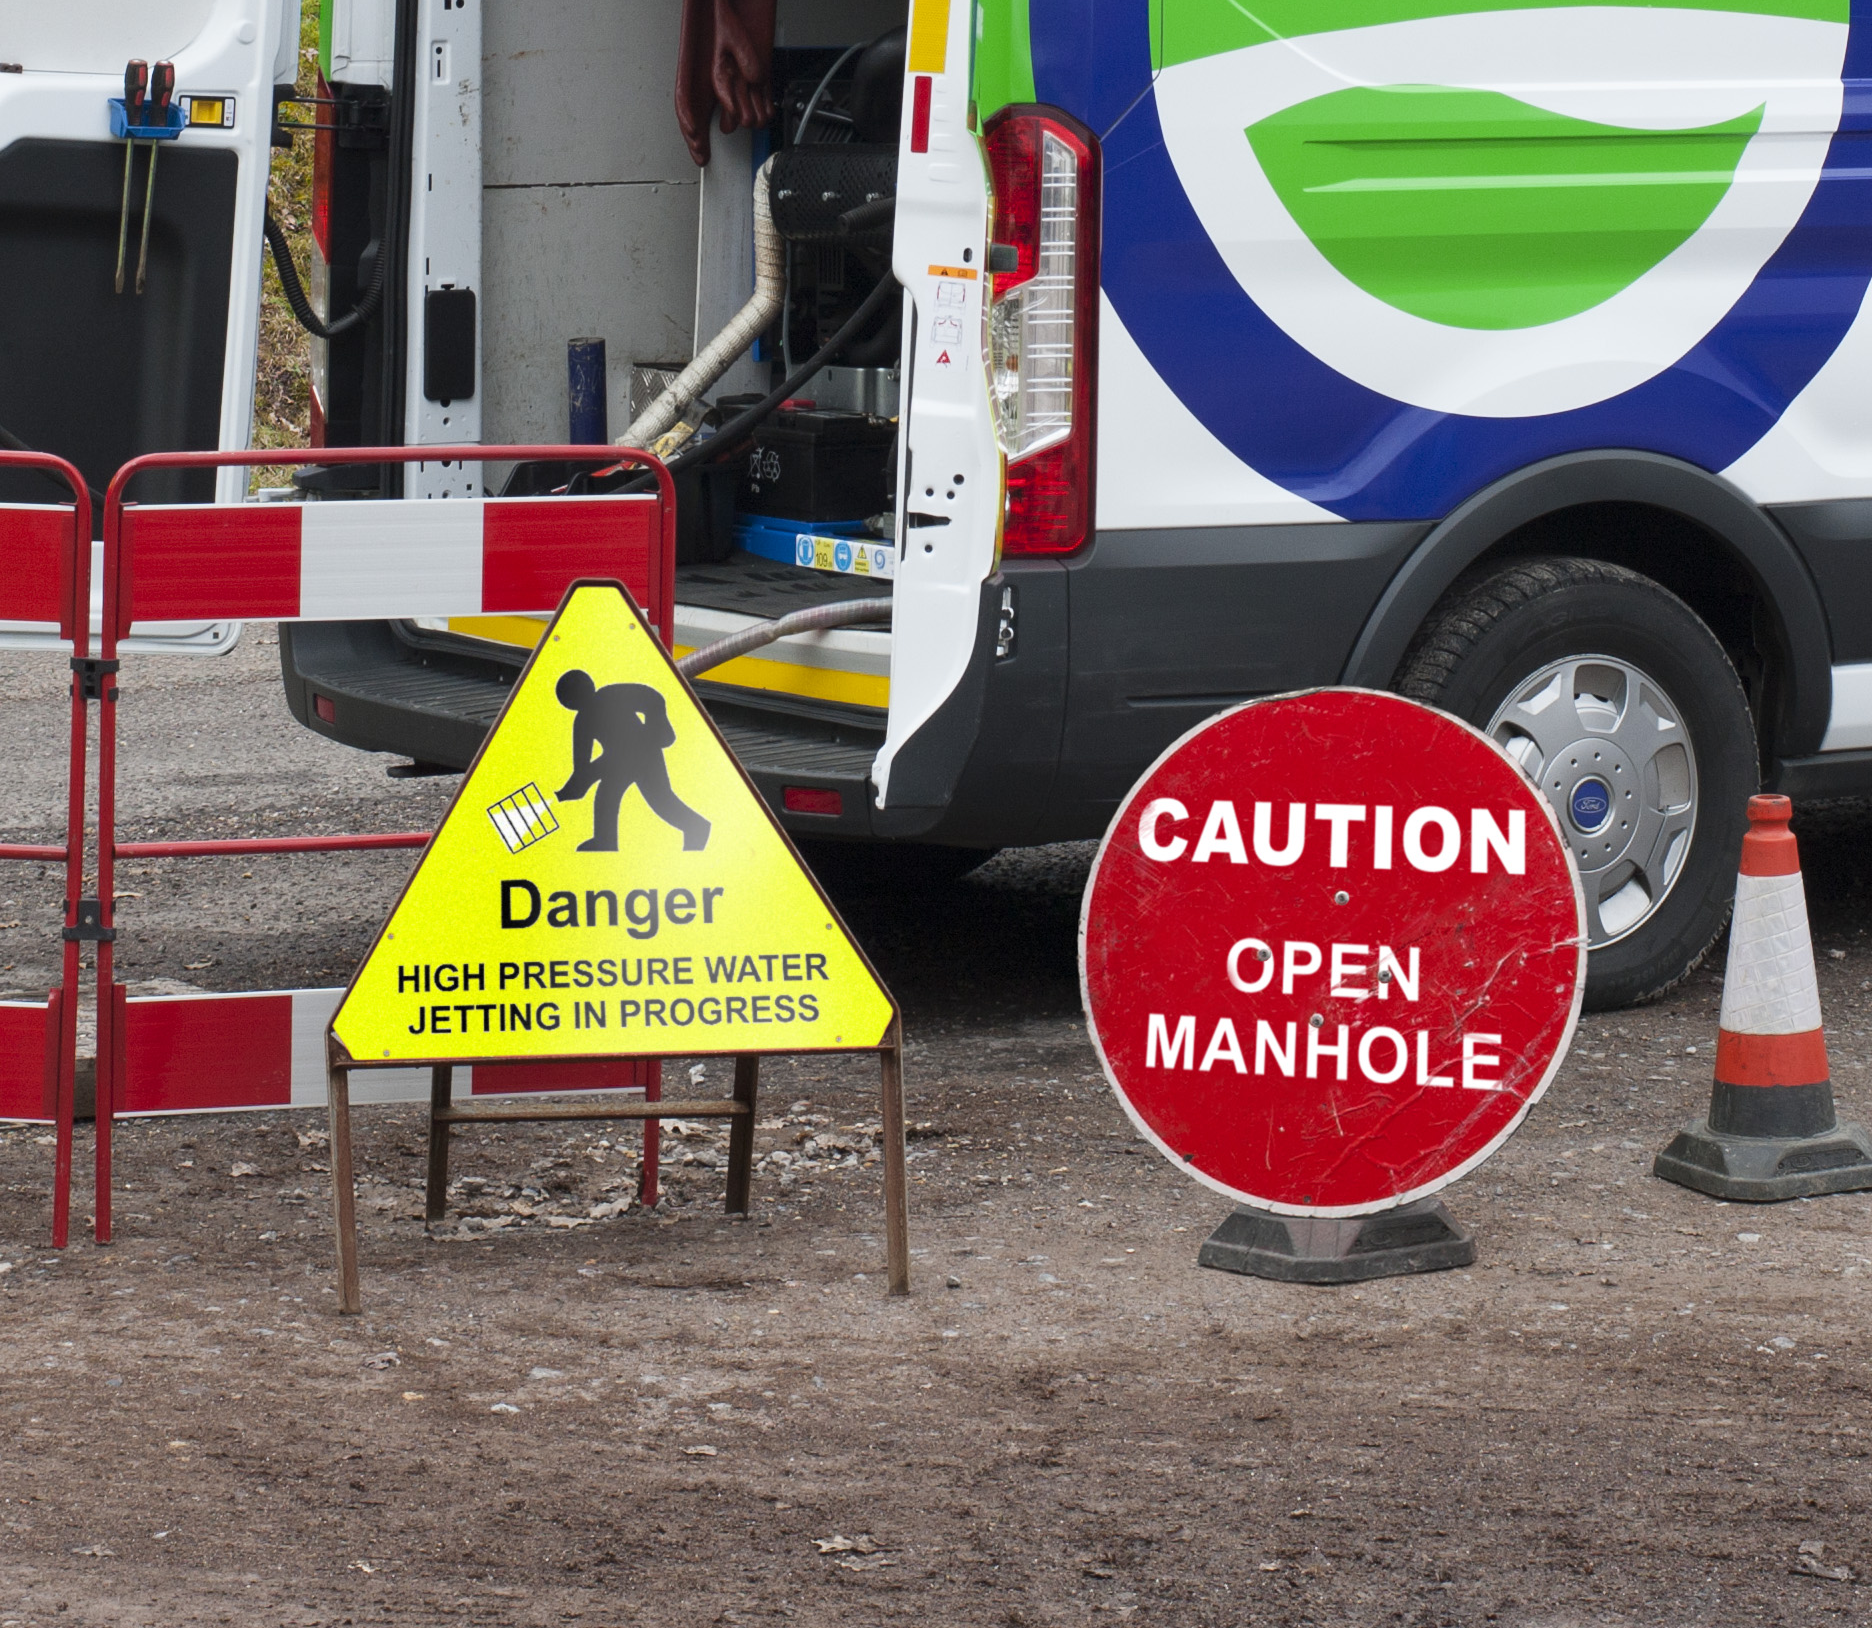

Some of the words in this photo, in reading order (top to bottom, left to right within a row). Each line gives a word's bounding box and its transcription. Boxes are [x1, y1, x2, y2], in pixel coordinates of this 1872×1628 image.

[1137, 797, 1527, 875] CAUTION
[500, 879, 724, 939] Danger
[398, 964, 485, 993] HIGH
[499, 957, 694, 991] PRESSURE
[704, 953, 829, 983] WATER
[1227, 938, 1420, 1002] OPEN
[408, 1001, 561, 1035] JETTING
[575, 1000, 607, 1029] IN
[620, 994, 820, 1027] PROGRESS
[1145, 1013, 1503, 1092] MANHOLE
